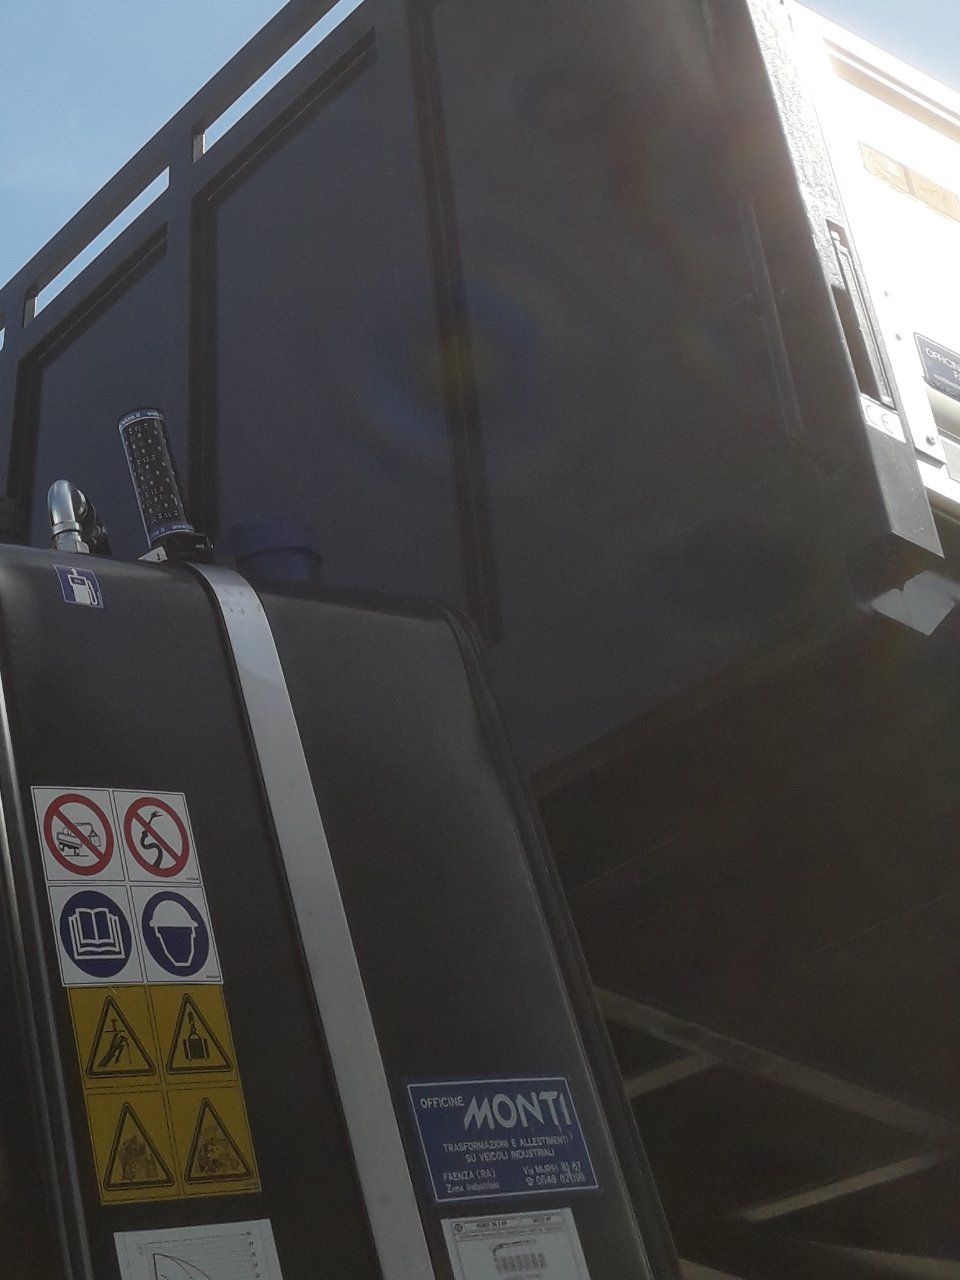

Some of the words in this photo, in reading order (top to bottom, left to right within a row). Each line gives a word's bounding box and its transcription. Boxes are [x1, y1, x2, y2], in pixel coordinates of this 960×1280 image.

[419, 1095, 465, 1109] OFFICINE
[464, 1091, 572, 1130] MONTI
[465, 1153, 477, 1163] SU
[479, 1150, 509, 1163] VEICOLI
